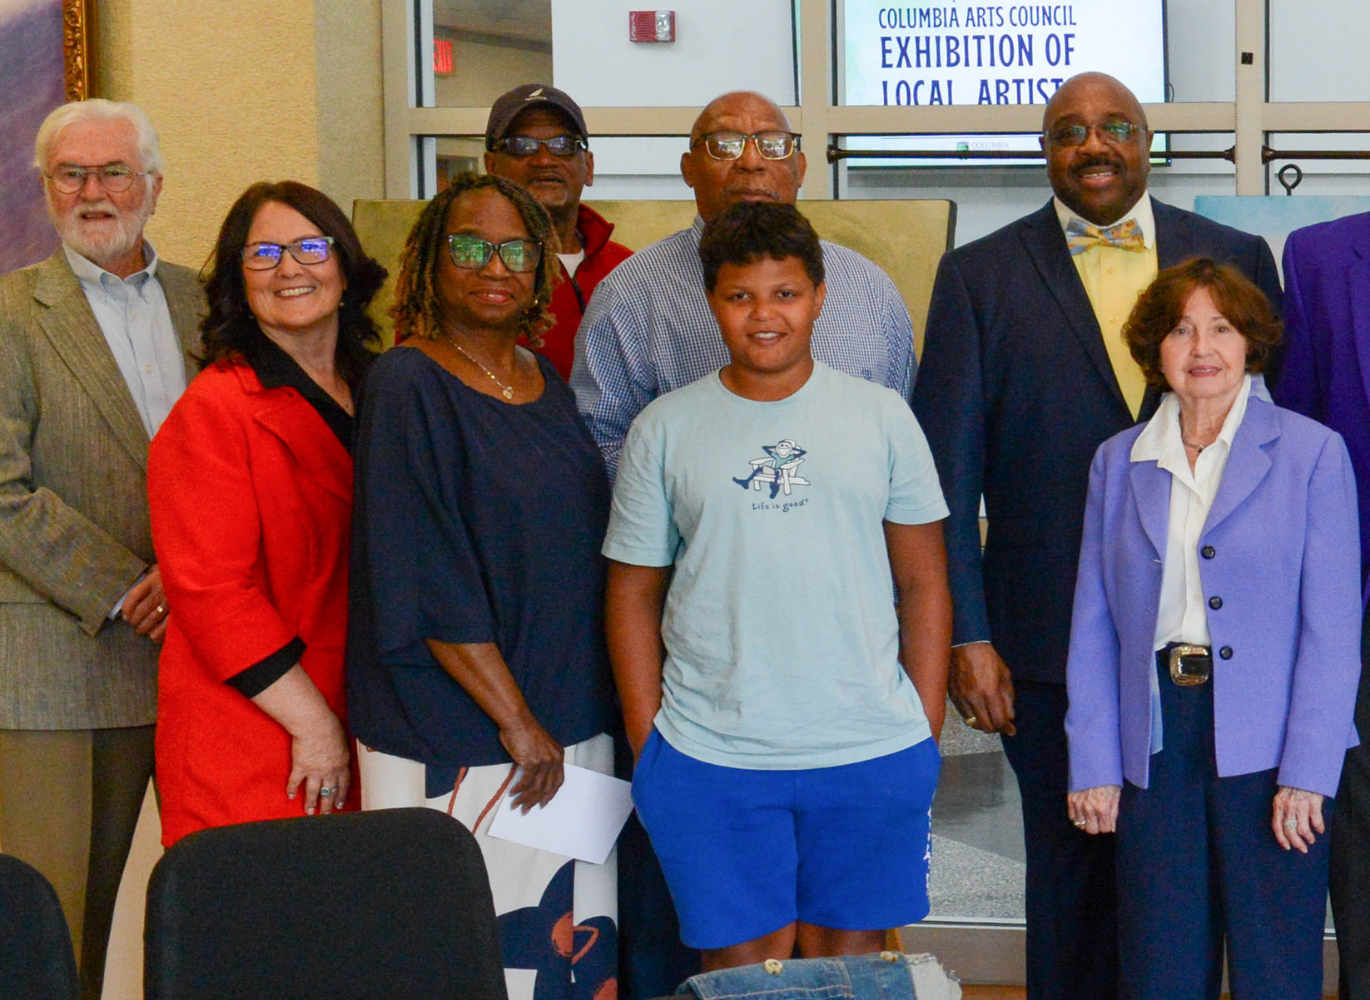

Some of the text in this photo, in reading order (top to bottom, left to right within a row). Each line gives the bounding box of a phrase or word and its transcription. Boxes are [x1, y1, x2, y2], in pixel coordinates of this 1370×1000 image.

[879, 5, 1077, 29] COLUMBIA ARTS COUNCIL
[880, 33, 1075, 68] EXHIBITION OF
[752, 501, 770, 511] Life
